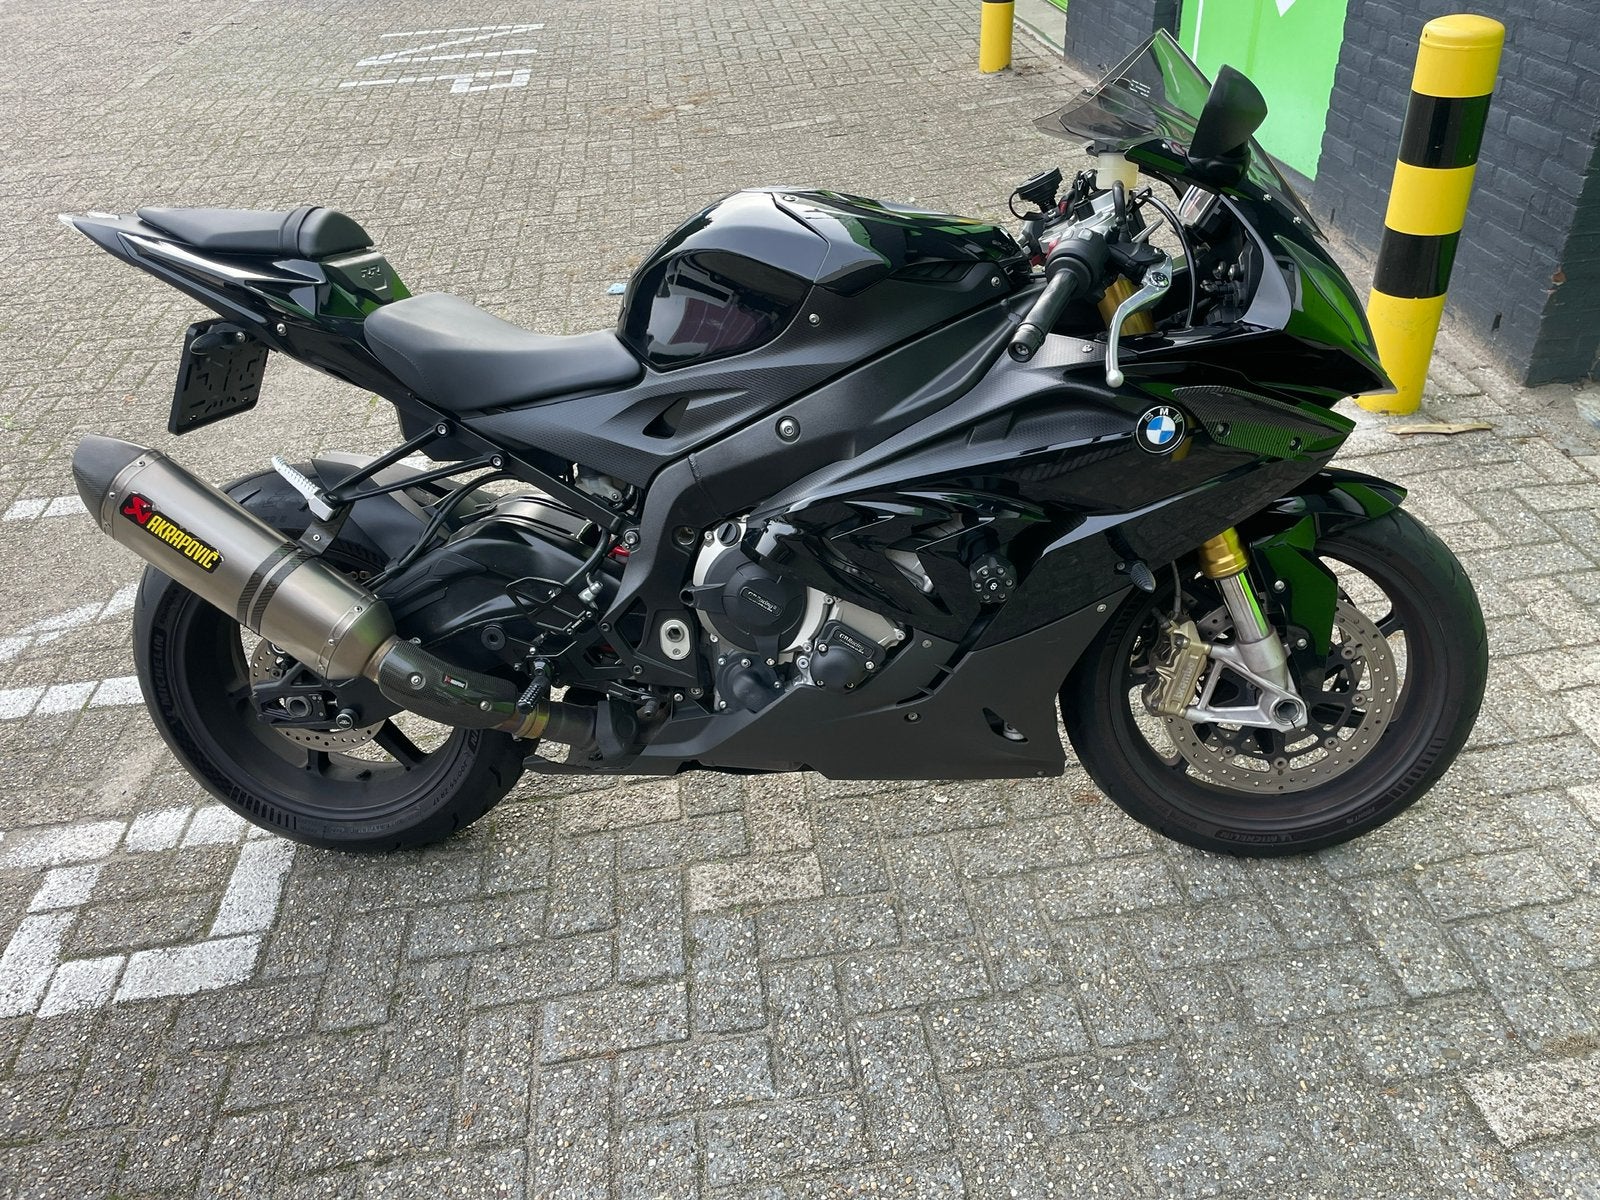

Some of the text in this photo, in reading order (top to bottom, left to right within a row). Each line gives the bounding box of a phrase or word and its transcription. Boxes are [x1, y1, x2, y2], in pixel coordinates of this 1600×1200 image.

[1144, 407, 1184, 424] BMW
[154, 634, 171, 706] MICHELIN
[1175, 662, 1194, 698] brembo
